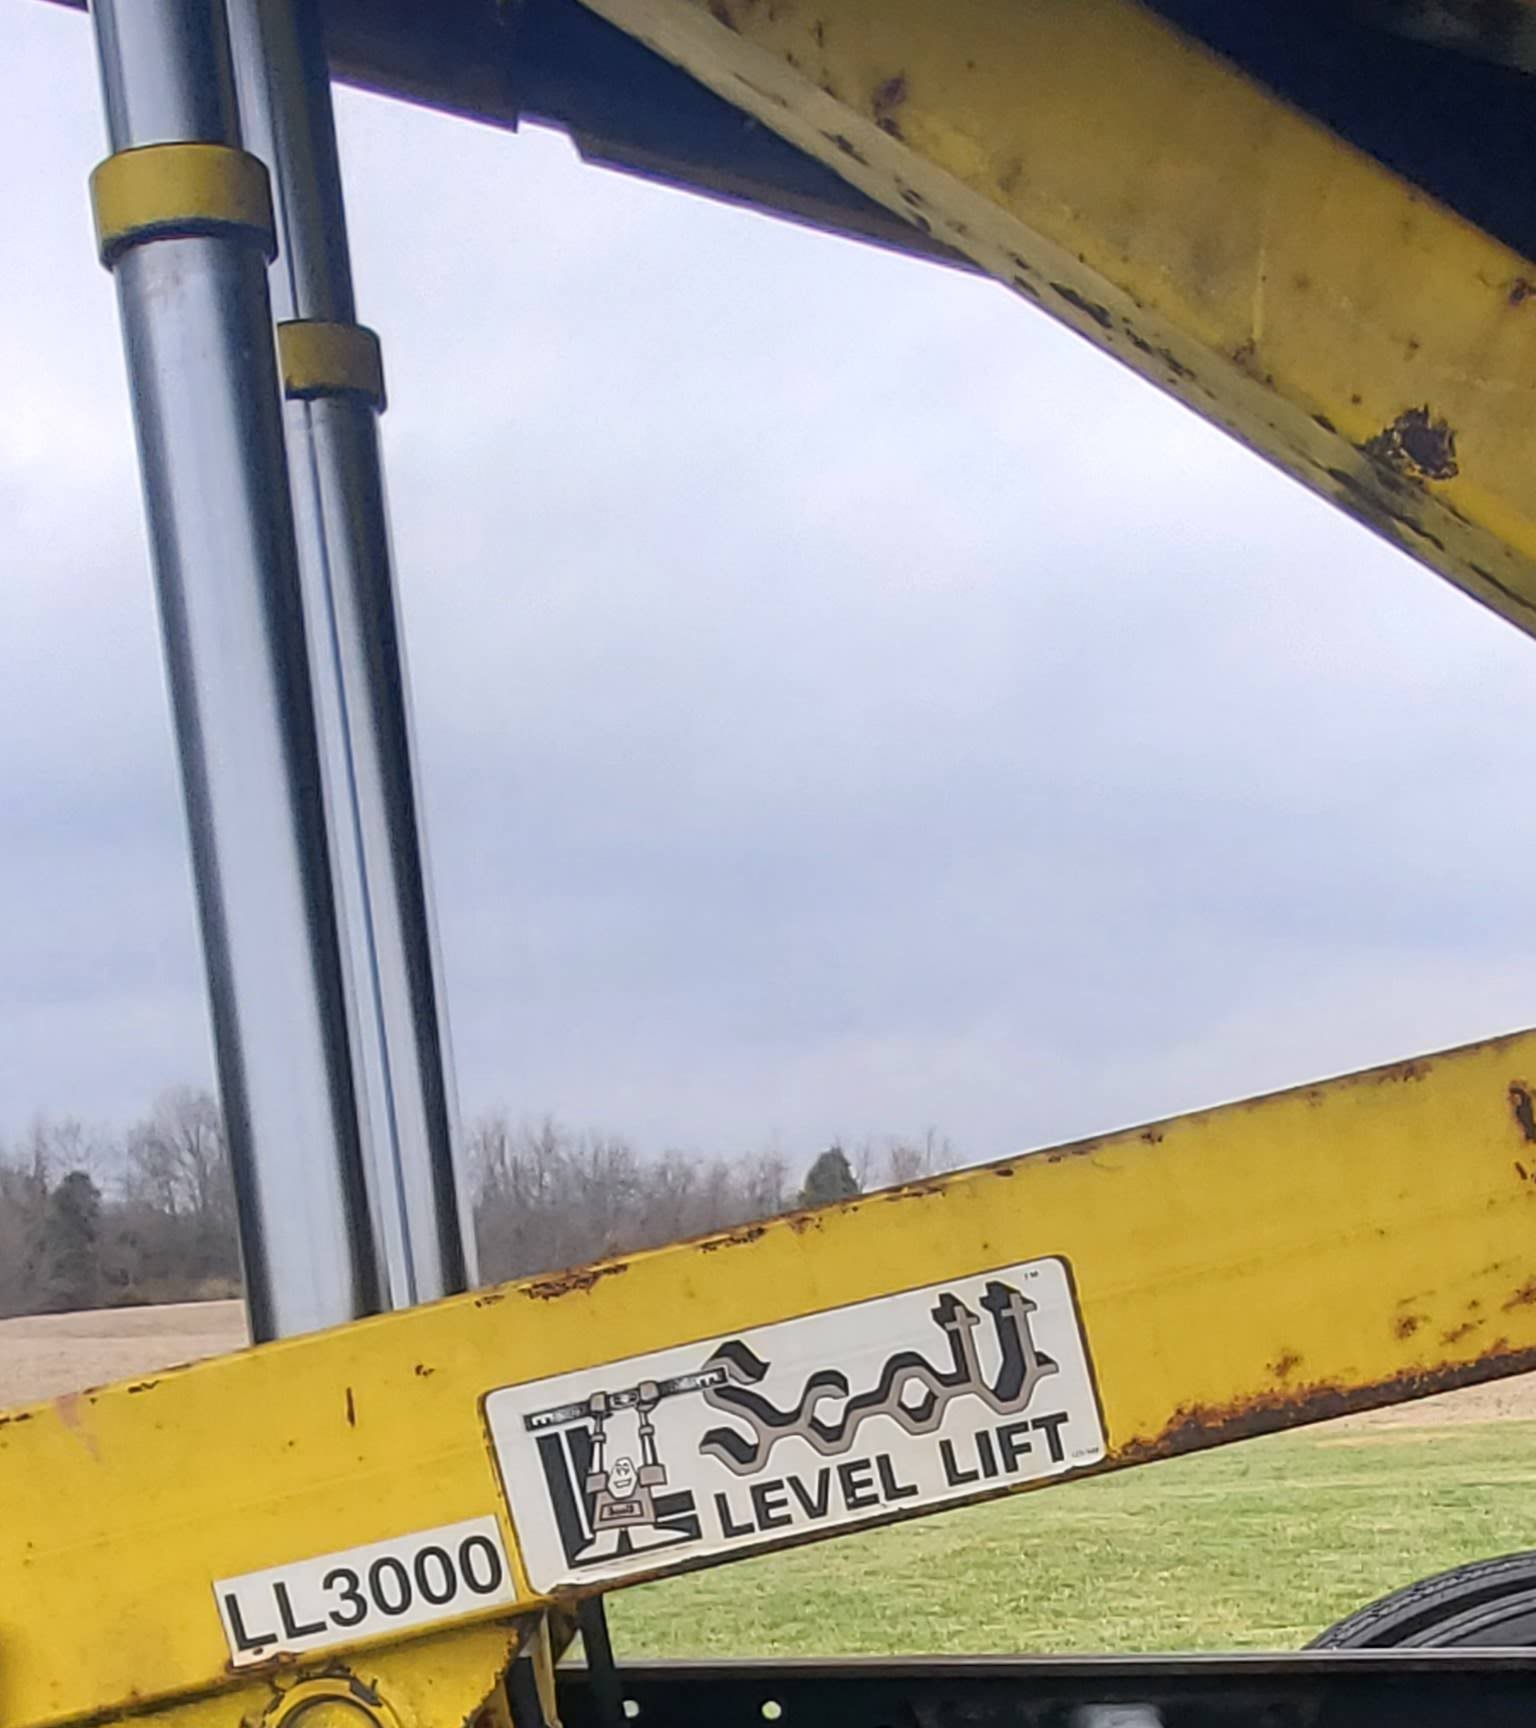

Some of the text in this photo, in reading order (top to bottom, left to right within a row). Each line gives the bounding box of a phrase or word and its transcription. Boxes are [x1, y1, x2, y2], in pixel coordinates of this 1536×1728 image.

[714, 1411, 1069, 1539] LEVEL LIFT
[224, 1534, 503, 1652] LL3000
